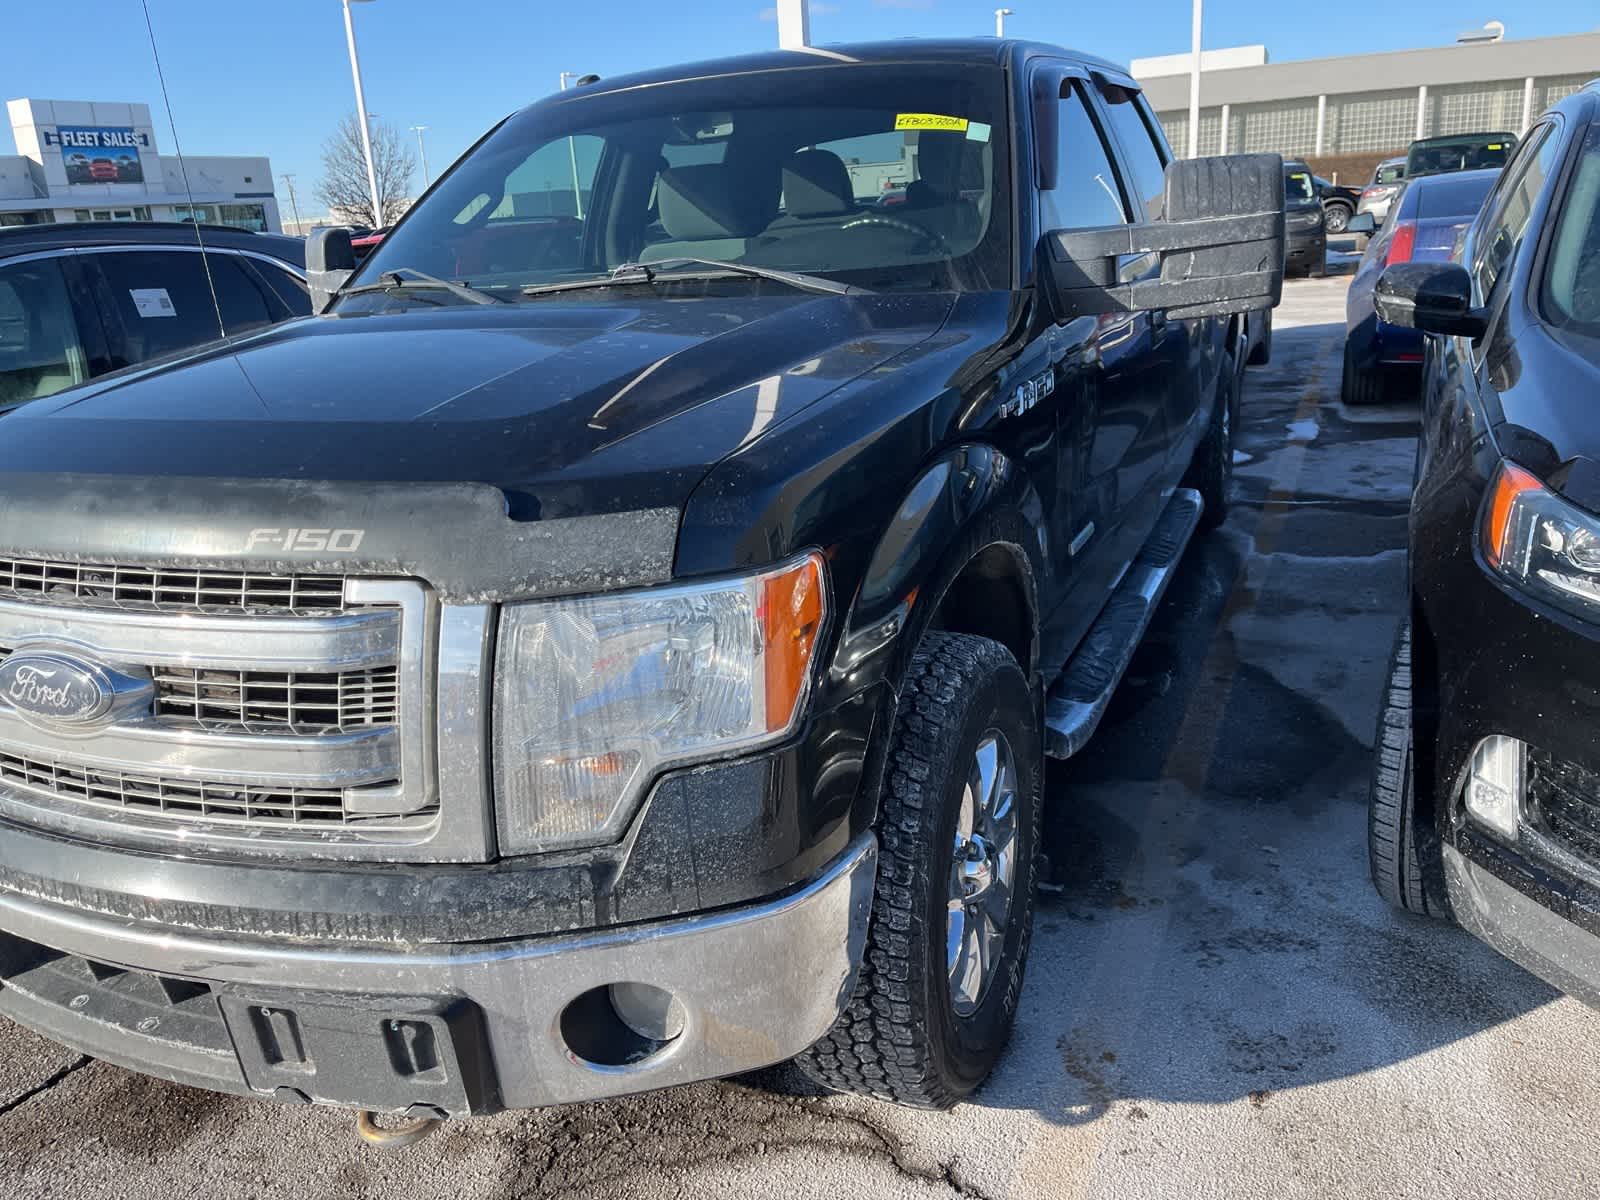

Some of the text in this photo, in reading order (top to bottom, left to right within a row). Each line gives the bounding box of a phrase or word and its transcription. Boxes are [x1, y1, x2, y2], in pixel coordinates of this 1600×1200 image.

[61, 131, 139, 147] FLEET SALES
[245, 528, 365, 552] F-150
[9, 665, 72, 708] Ford
